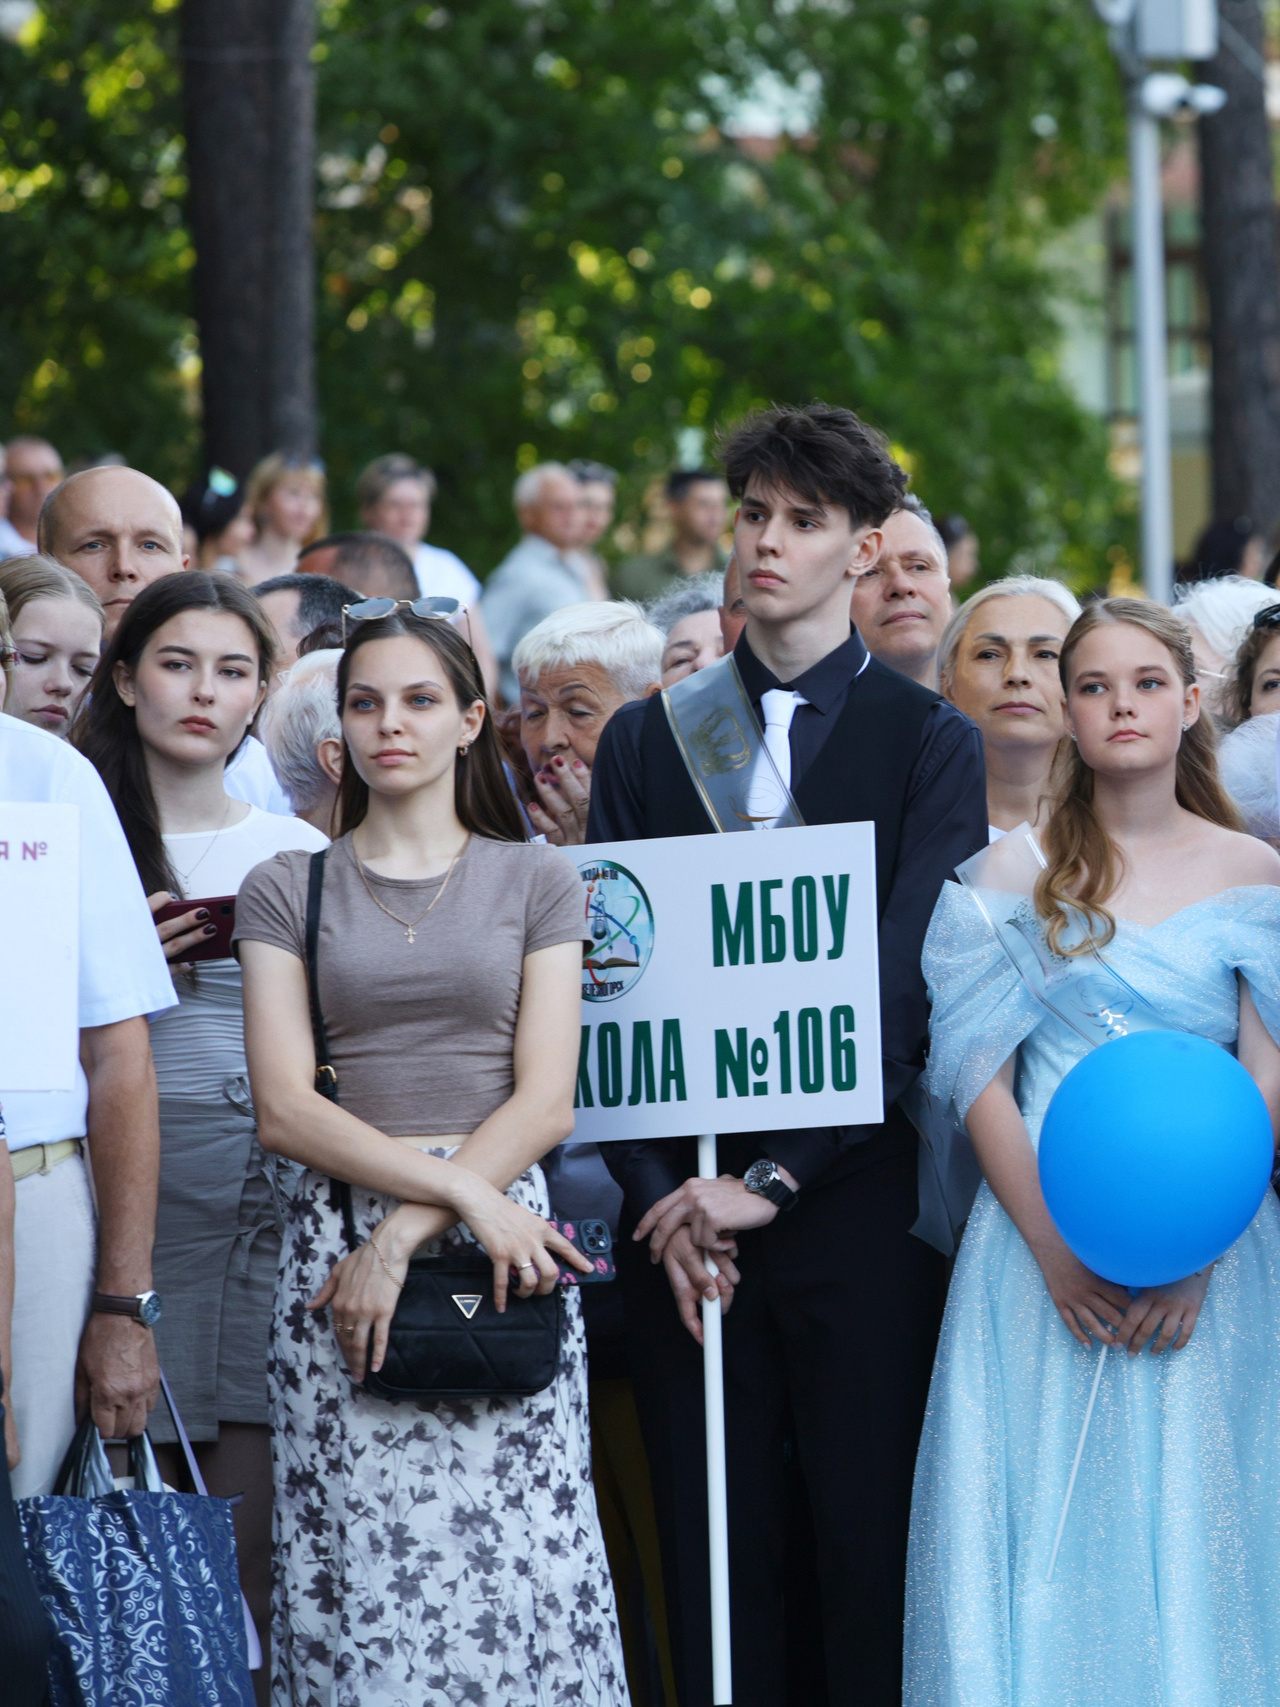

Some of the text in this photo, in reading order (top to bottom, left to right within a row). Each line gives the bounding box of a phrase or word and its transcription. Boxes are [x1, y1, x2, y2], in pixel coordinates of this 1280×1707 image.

[22, 841, 48, 860] №
[711, 873, 850, 967] МБОУ
[573, 1004, 857, 1109] КОЛА №106
